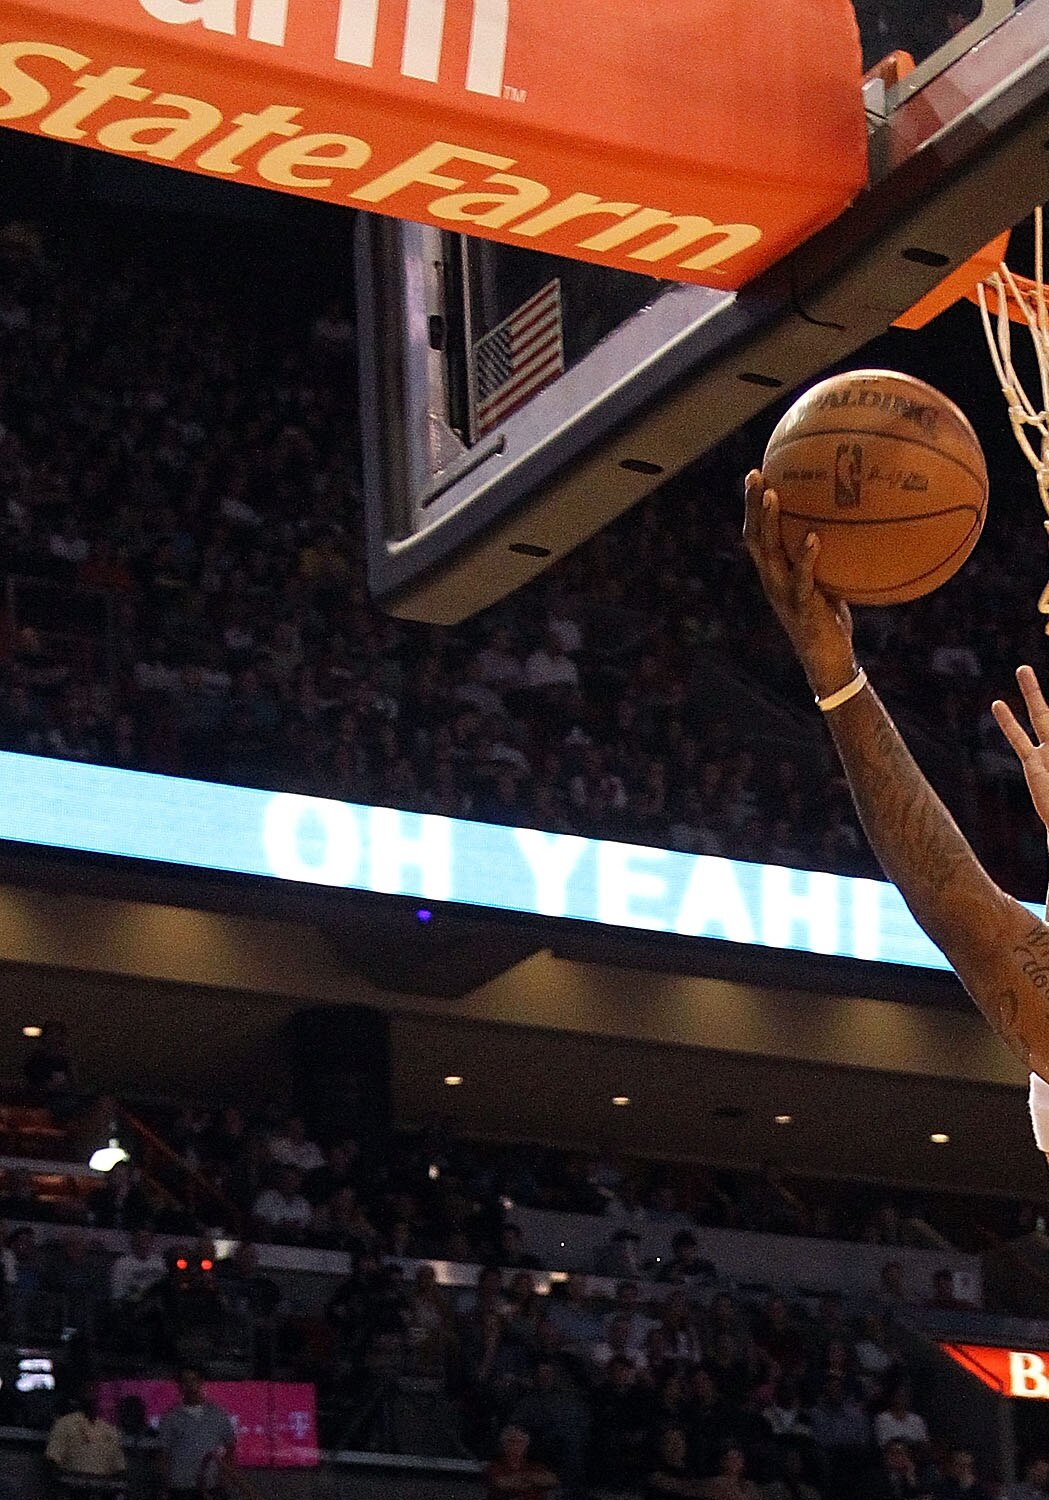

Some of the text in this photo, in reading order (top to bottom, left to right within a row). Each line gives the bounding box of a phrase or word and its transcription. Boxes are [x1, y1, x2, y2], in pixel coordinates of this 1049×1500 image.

[0, 41, 762, 272] State Farm
[263, 793, 453, 901] OH
